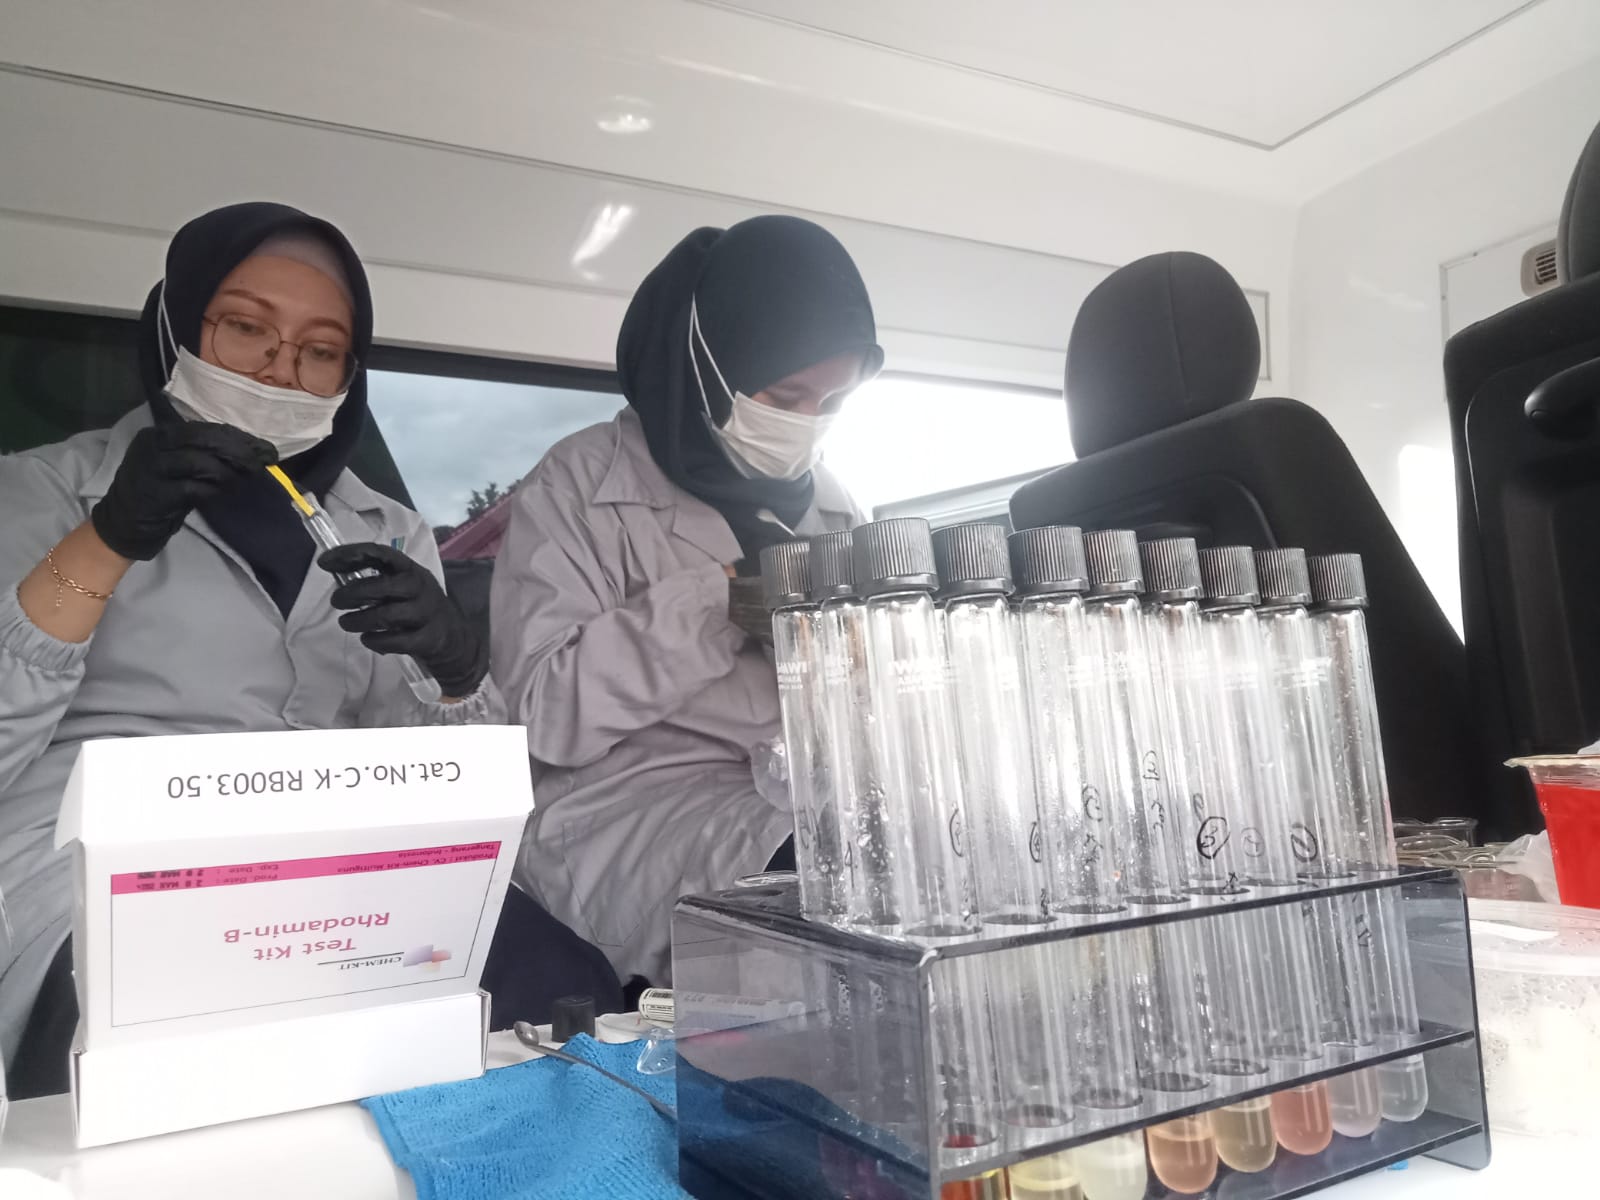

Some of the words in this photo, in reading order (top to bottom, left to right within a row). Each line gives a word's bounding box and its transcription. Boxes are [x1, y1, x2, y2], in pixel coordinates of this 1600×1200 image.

[314, 761, 461, 790] Cat.No.C-K
[168, 769, 303, 799] RB003.50
[398, 849, 442, 858] Indonesia
[451, 843, 494, 852] Tangerang
[229, 866, 252, 874] Date
[337, 863, 384, 874] Multiguna
[224, 876, 247, 884] Date
[223, 912, 390, 943] Rhodamin-B
[253, 945, 291, 962] Kit
[302, 937, 356, 955] Test
[337, 956, 402, 971] CHEM-KIT
